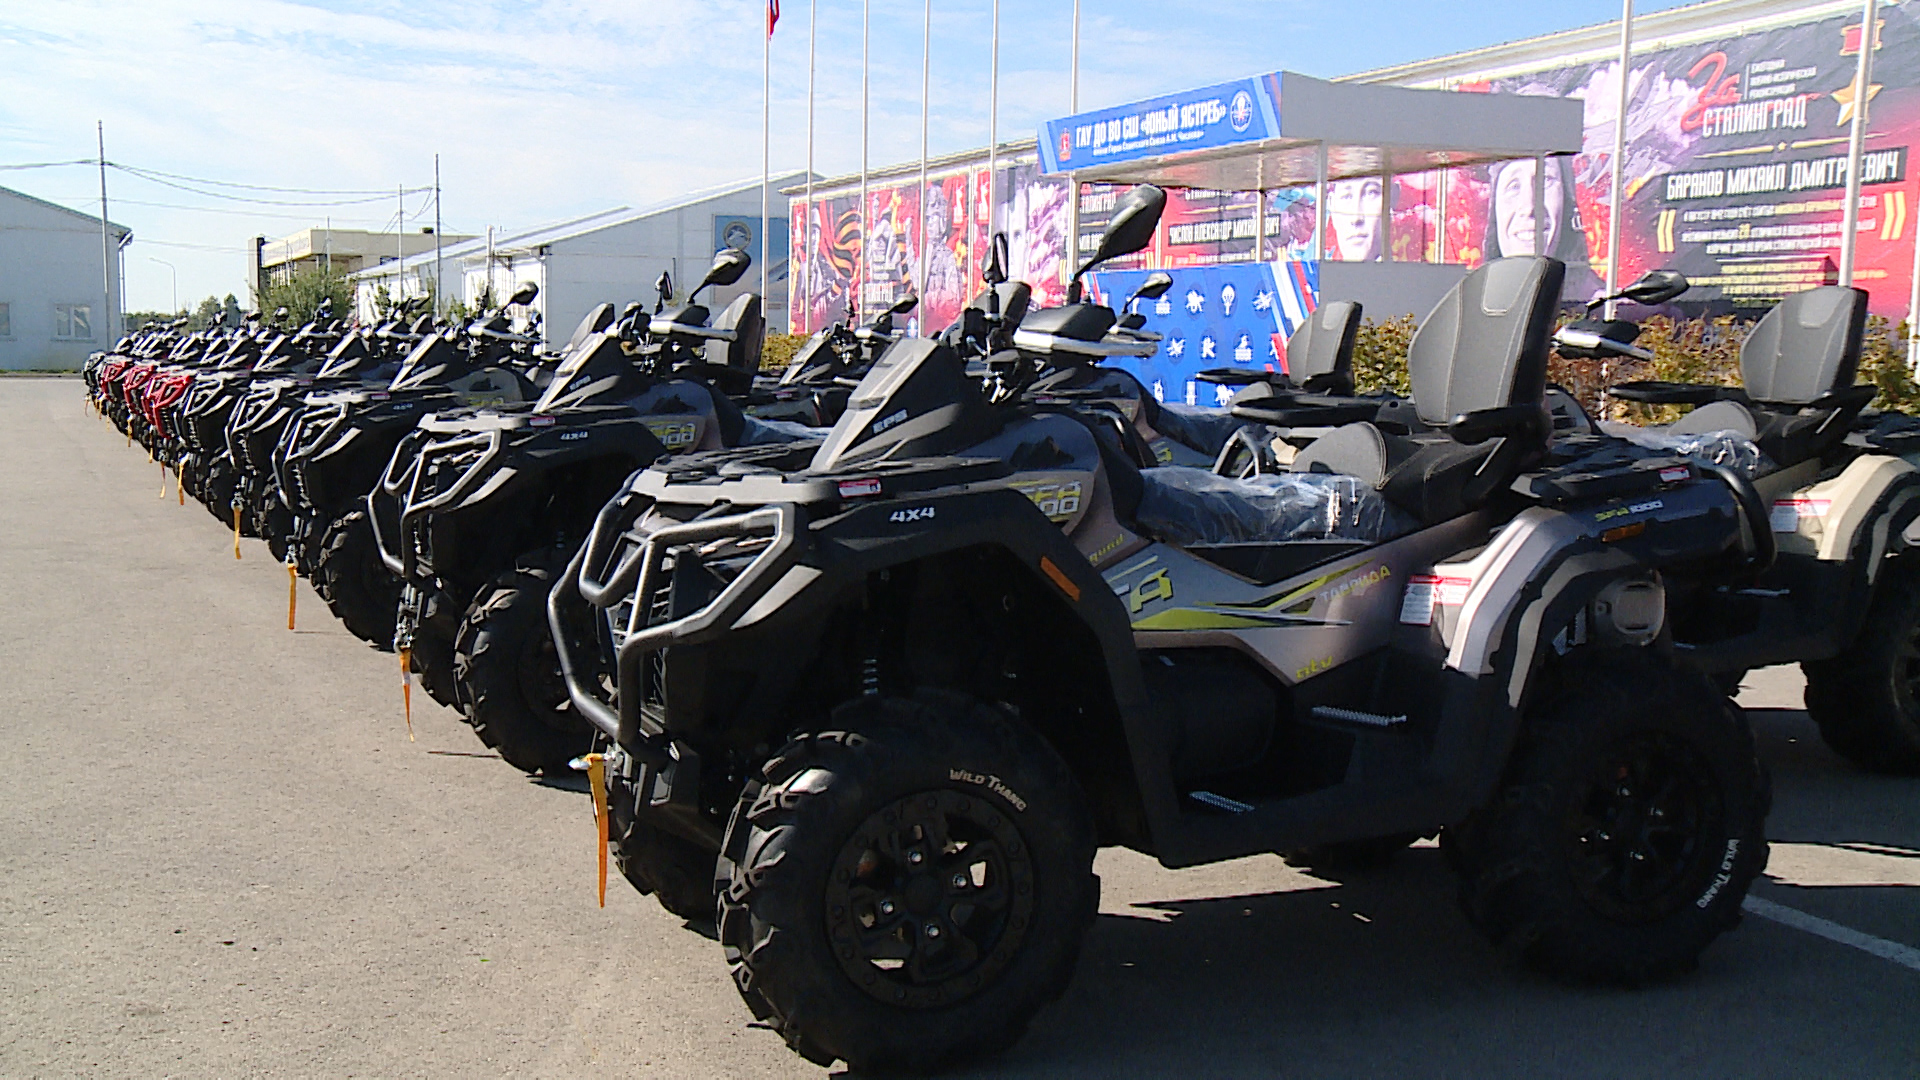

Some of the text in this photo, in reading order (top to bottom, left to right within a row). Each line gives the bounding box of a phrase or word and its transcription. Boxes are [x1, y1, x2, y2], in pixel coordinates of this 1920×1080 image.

[1076, 125, 1092, 148] ГАУ
[1093, 122, 1107, 148] ДО
[1108, 119, 1121, 143] ВО
[1122, 115, 1139, 140] СШ
[1181, 98, 1227, 130] ЯСТРЕБ»
[1702, 95, 1807, 138] СТАЛИНГРАД
[1666, 150, 1900, 201] БАРАНОВ МИХАИЛ ДМИТРЕВИЧ
[872, 409, 908, 434] EPS
[889, 506, 936, 523] 4X4
